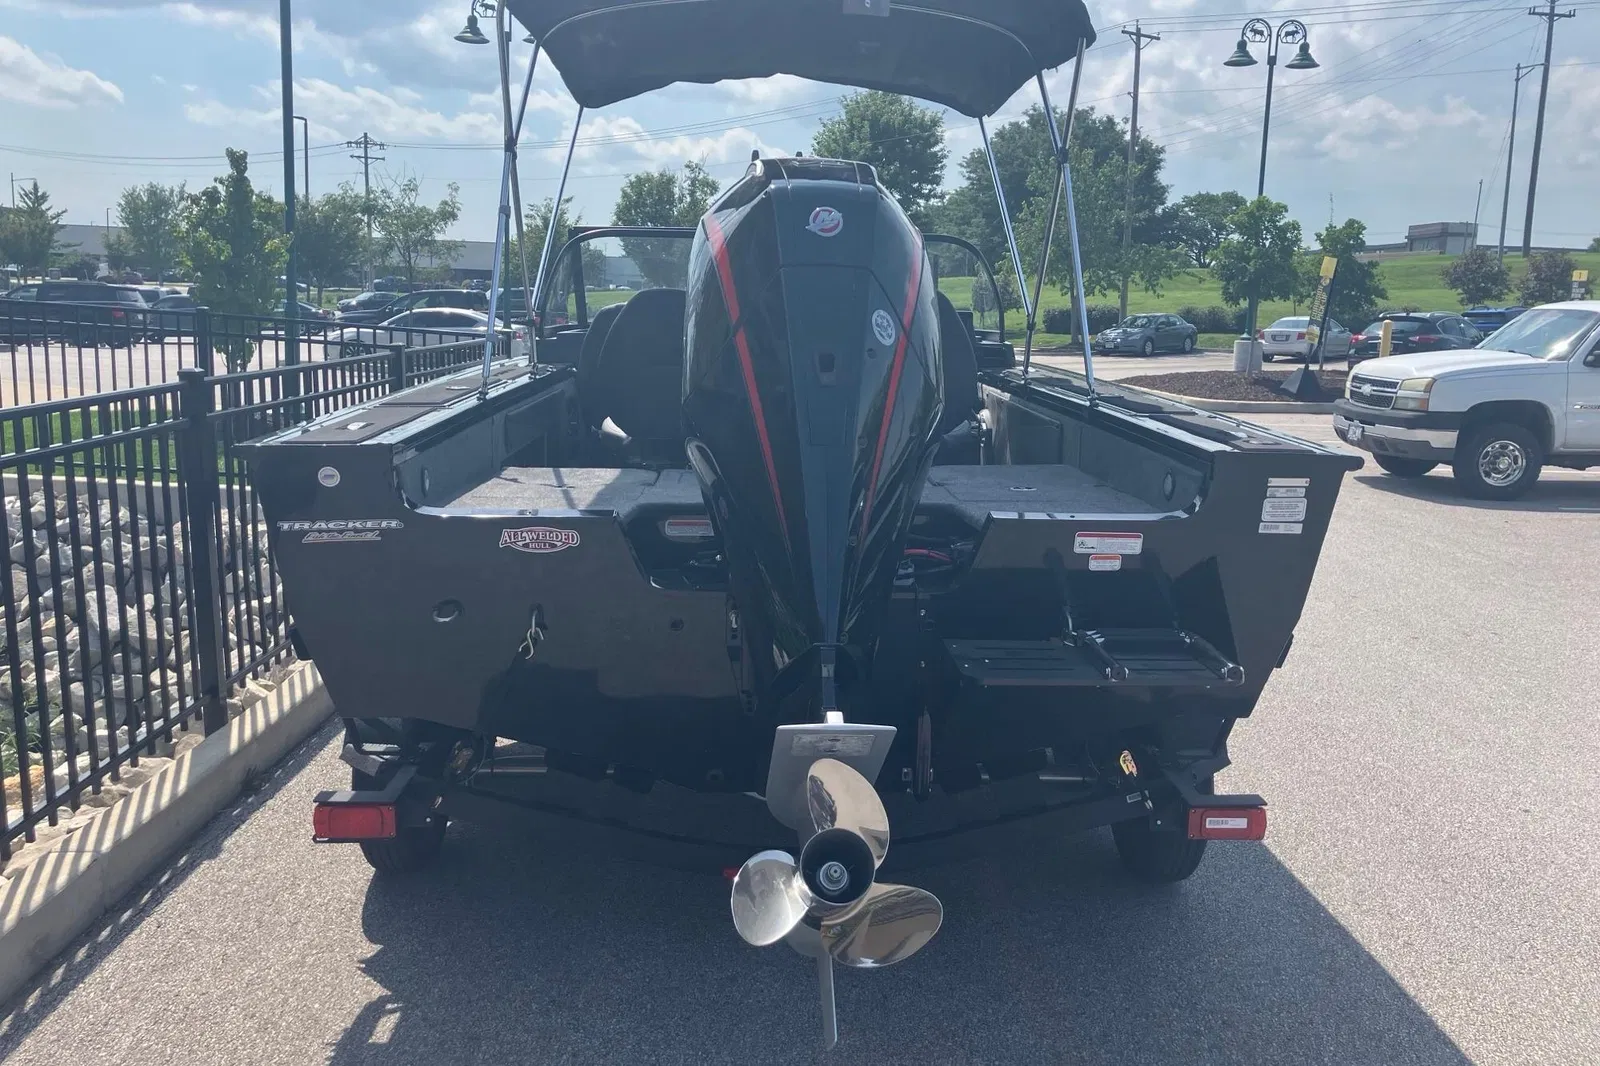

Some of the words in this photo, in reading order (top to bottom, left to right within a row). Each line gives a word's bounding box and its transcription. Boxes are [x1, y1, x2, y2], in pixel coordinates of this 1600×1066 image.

[279, 519, 398, 530] TRACKER
[502, 531, 525, 544] ALL
[524, 531, 577, 544] WELDED
